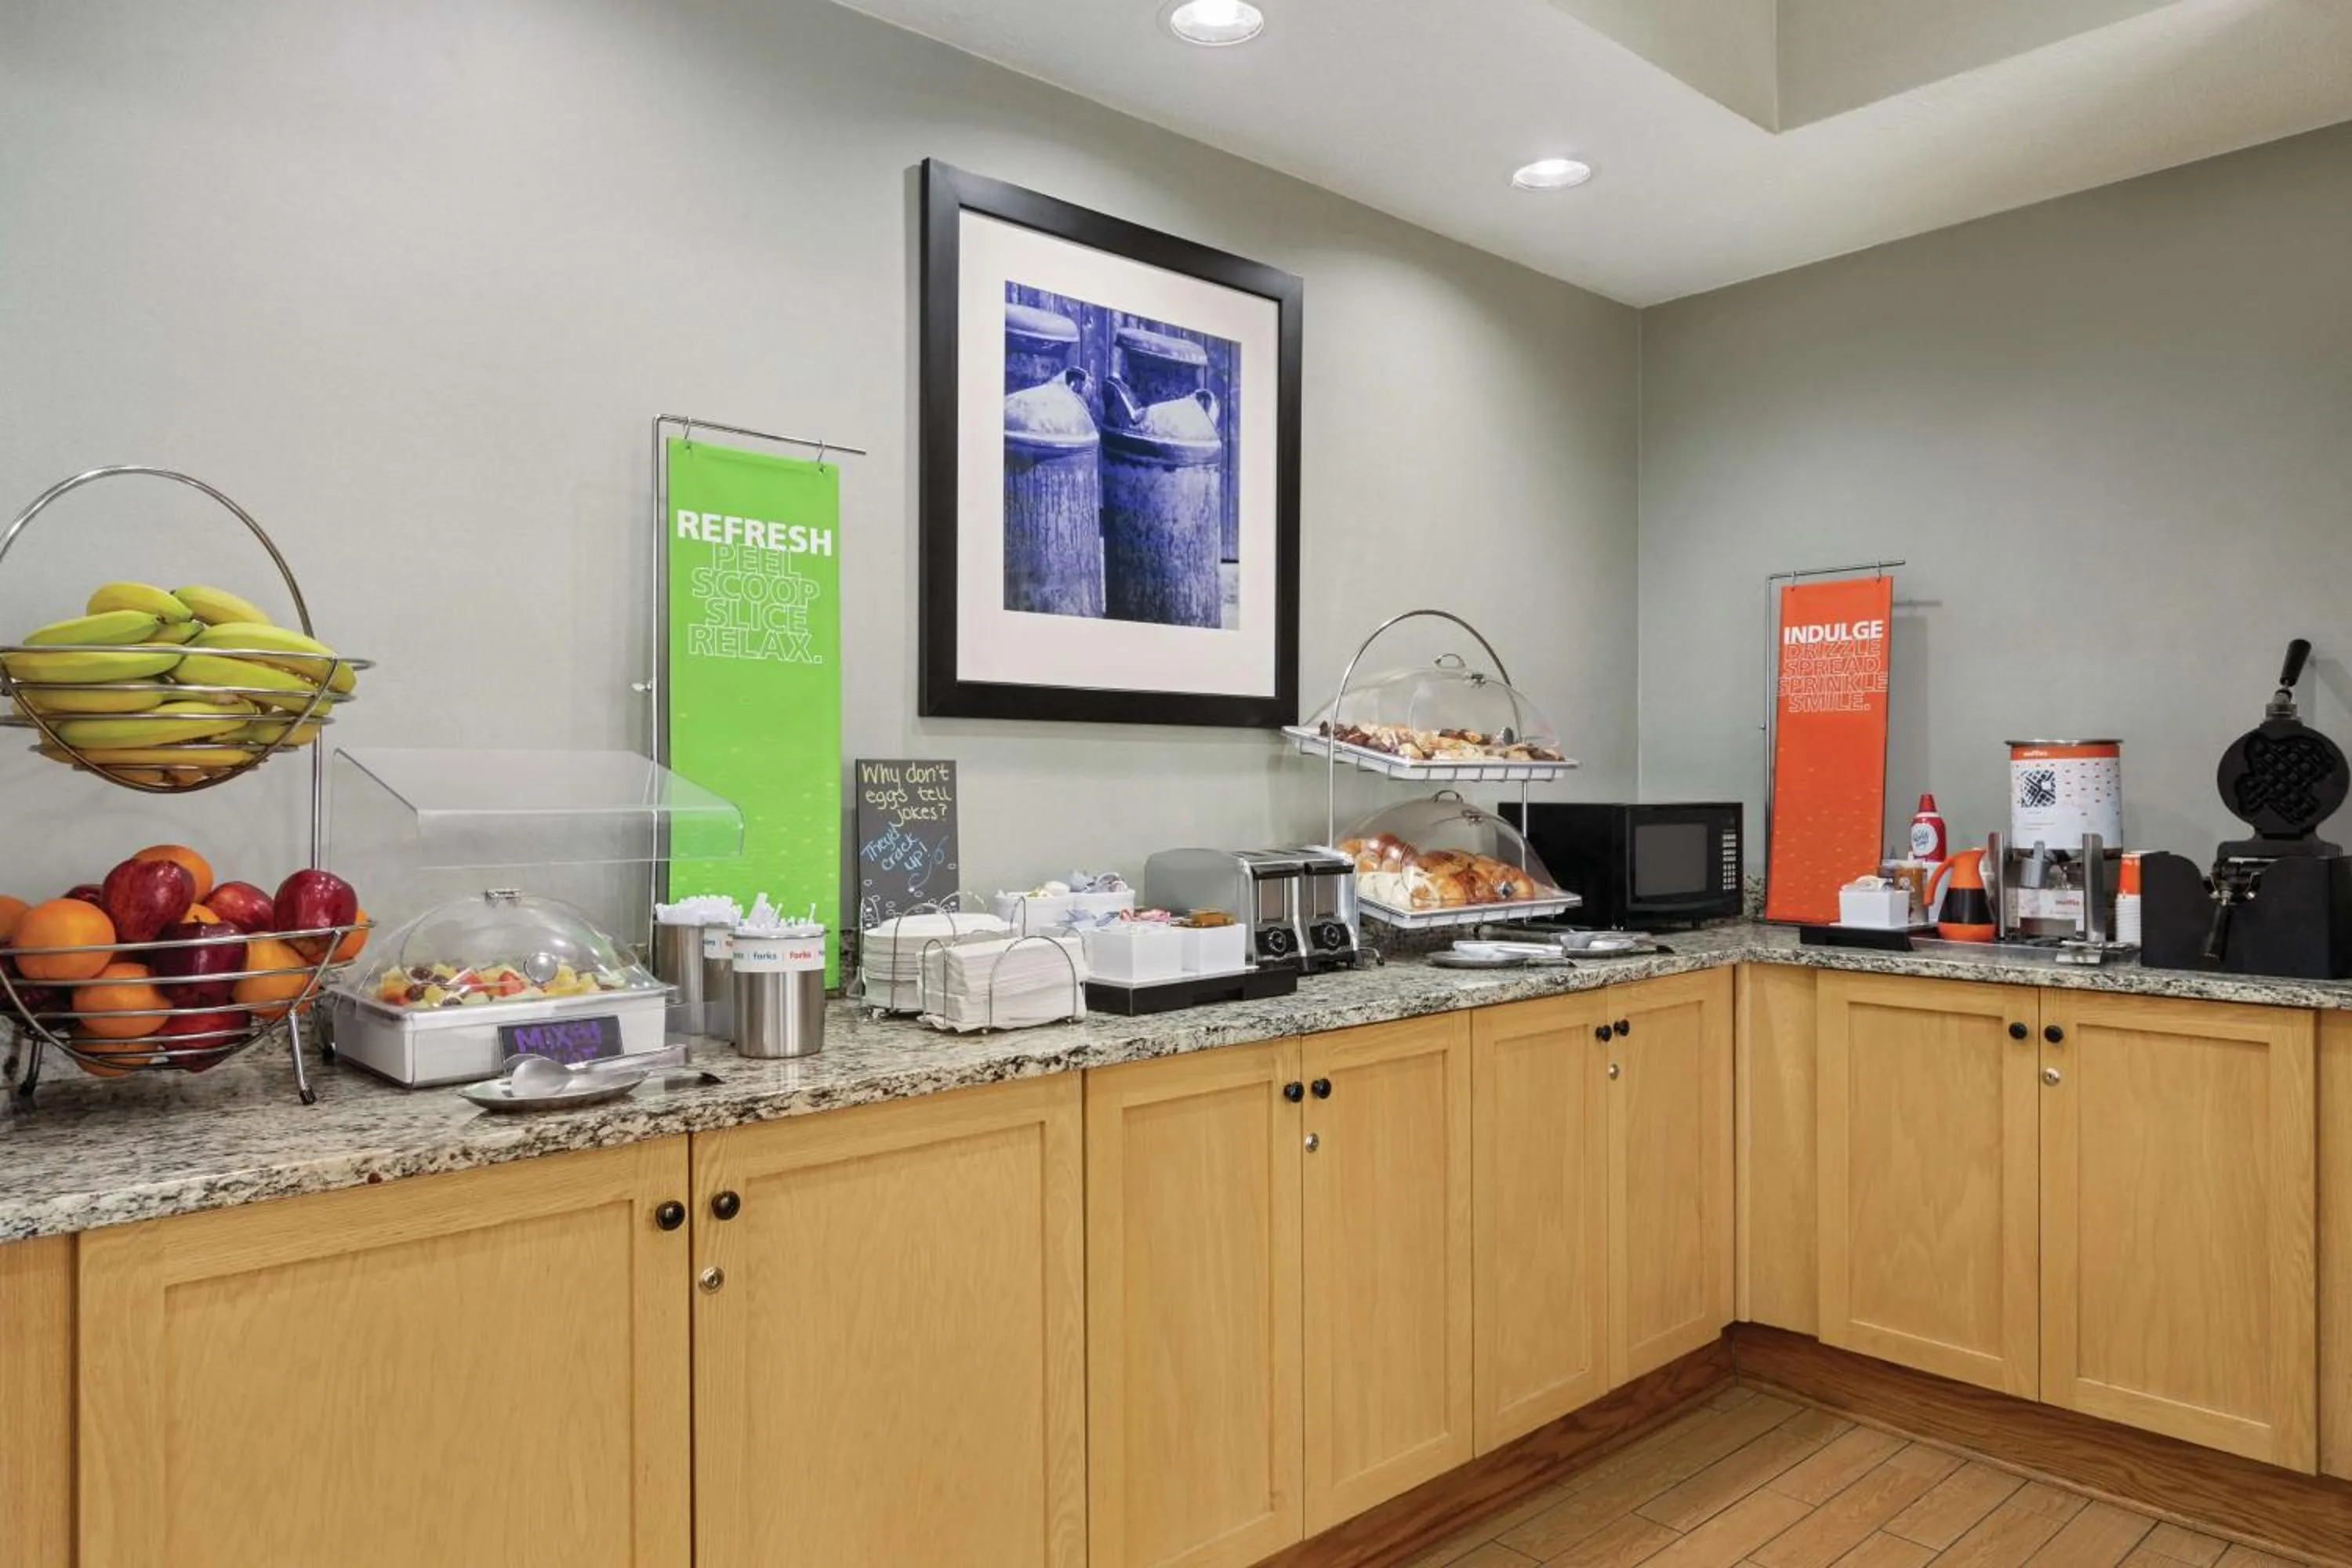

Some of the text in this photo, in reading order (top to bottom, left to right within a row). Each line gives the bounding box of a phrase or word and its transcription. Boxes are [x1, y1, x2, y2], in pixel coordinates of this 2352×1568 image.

[677, 509, 832, 557] REFRESH
[712, 542, 801, 583] PEEL
[691, 567, 821, 608] SCOOP
[705, 597, 808, 635] SLICE
[688, 623, 822, 664] RELAX.
[1784, 619, 1884, 645] INDULGE
[1785, 639, 1882, 659] DRIZZLE
[1784, 656, 1882, 677] SPREAD
[1777, 672, 1888, 697] SPRINKLE
[1788, 691, 1871, 713] SMILE.
[862, 762, 949, 789] Why don't
[866, 787, 953, 810] eggs tell
[892, 804, 947, 827] jokes?
[881, 833, 919, 871] crack
[753, 951, 777, 960] forks
[789, 950, 811, 960] forks
